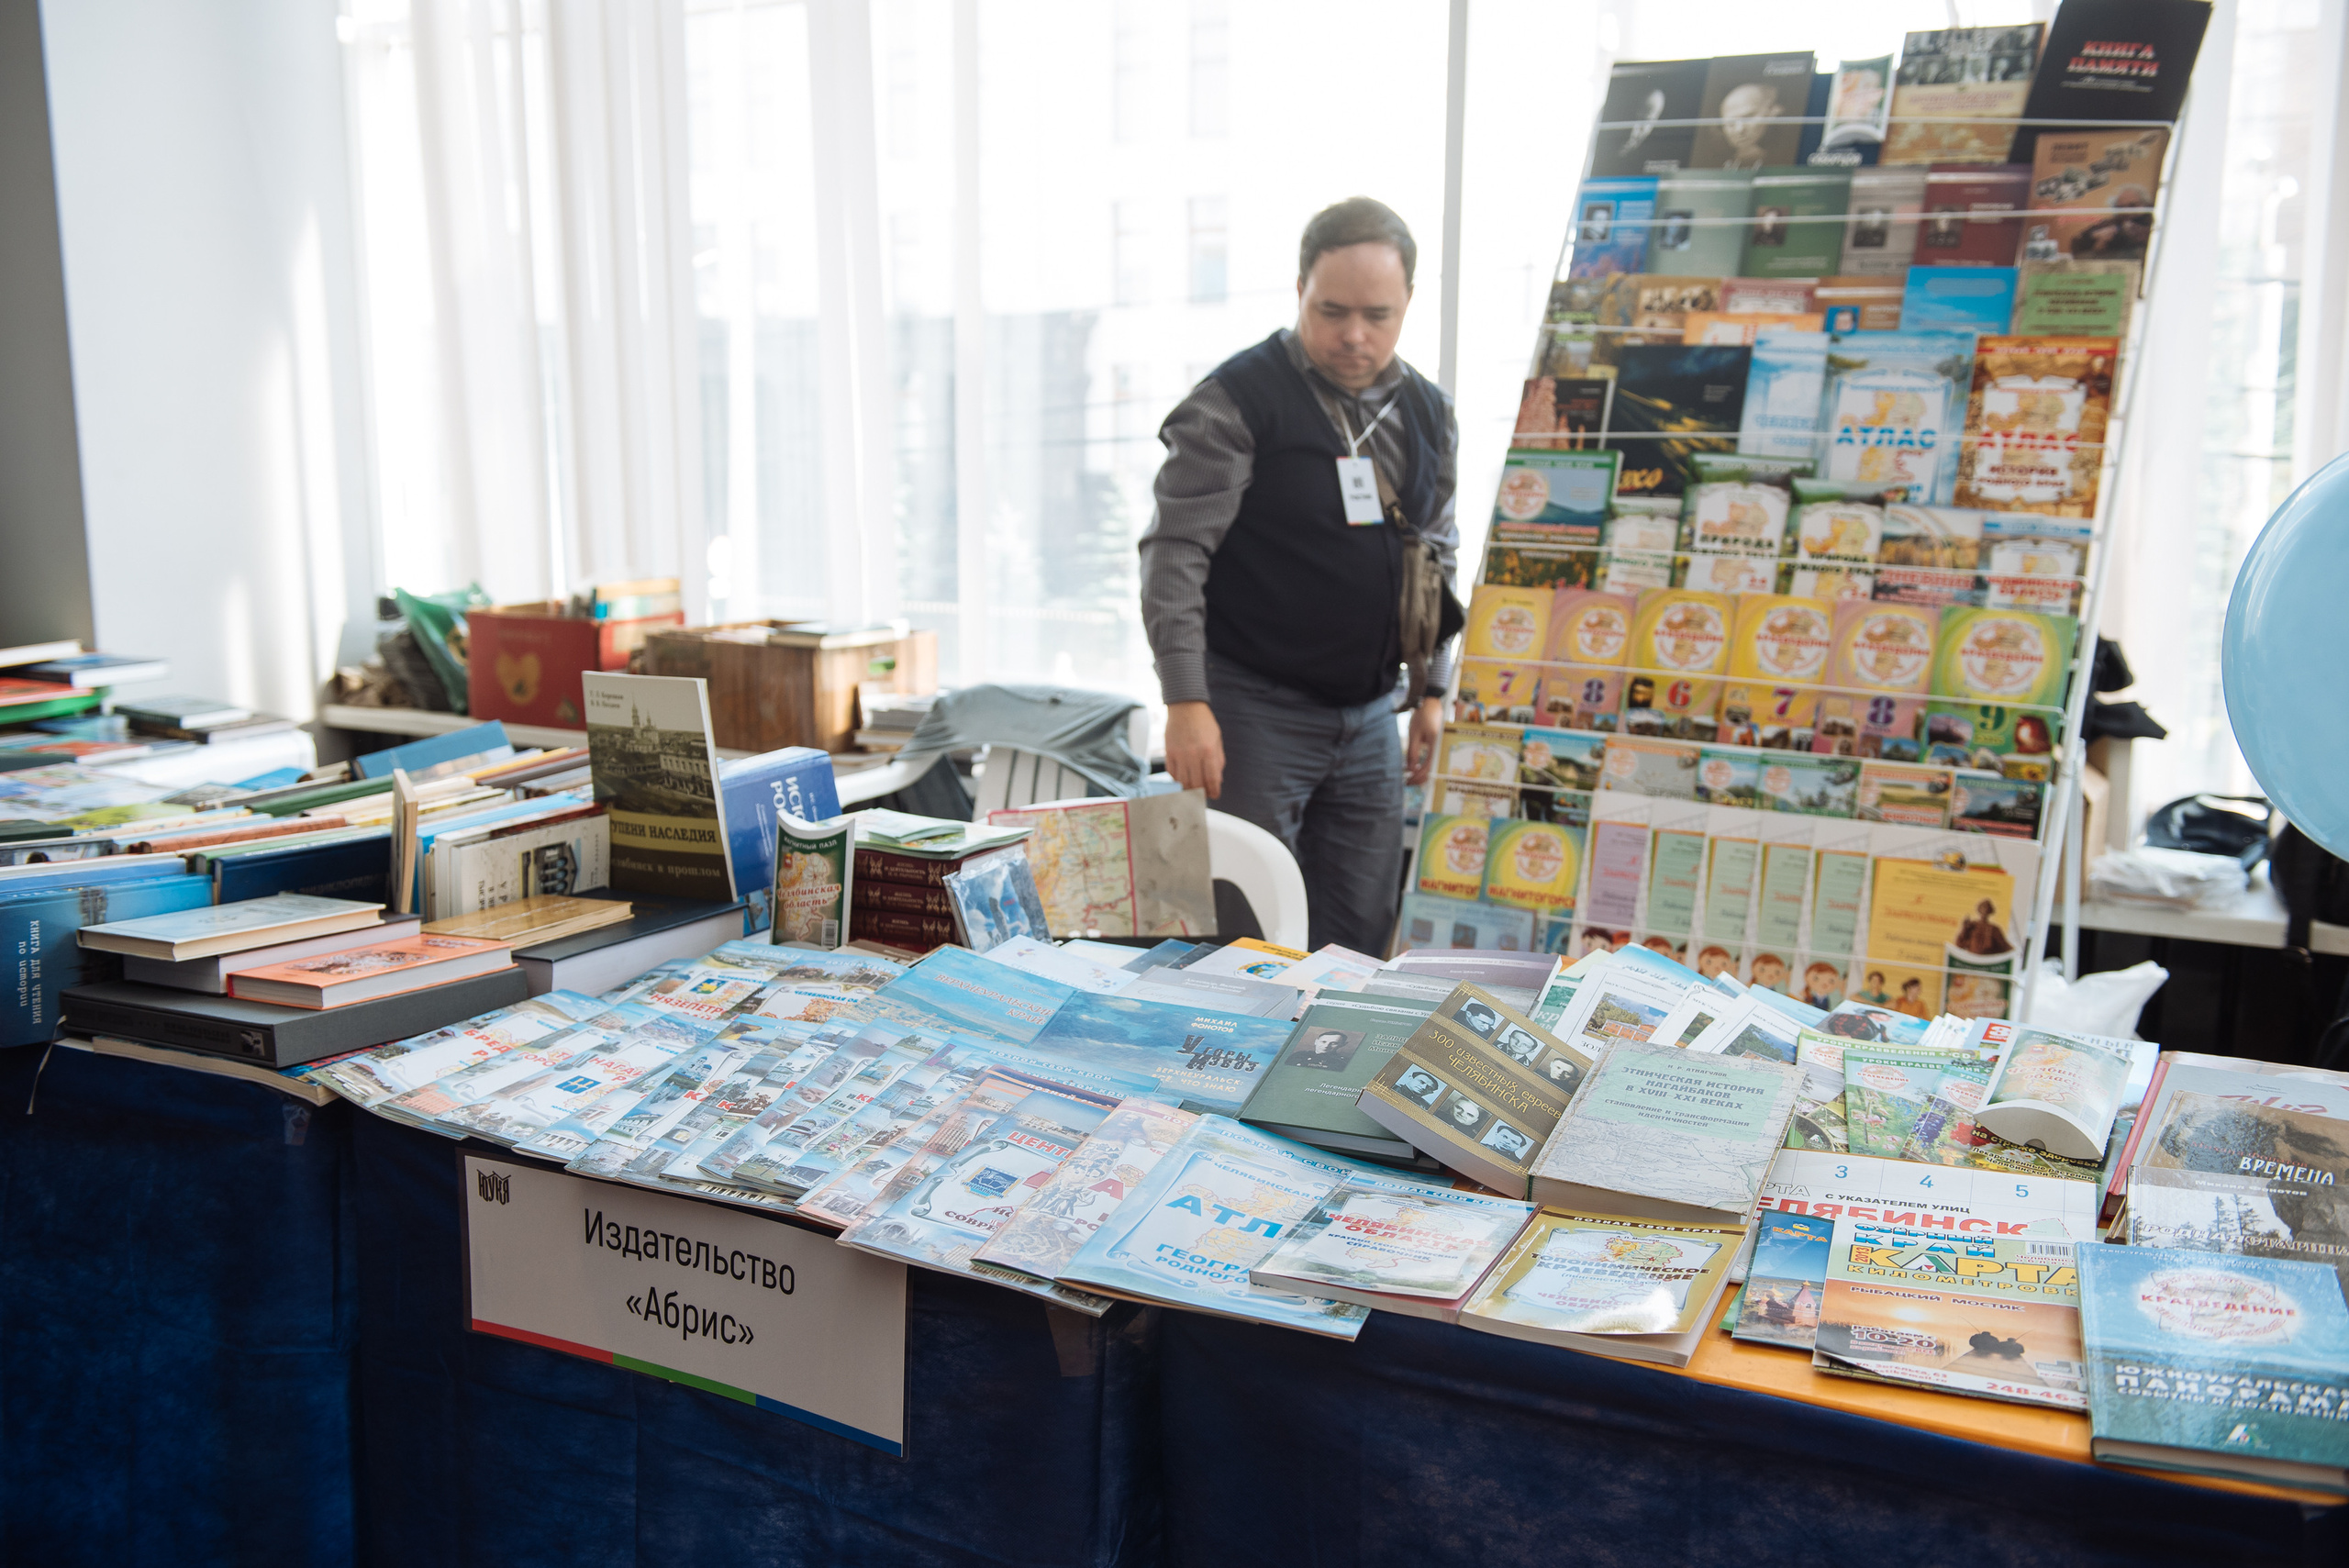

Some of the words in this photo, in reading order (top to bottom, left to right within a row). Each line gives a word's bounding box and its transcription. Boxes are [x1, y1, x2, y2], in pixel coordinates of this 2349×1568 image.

[2079, 39, 2155, 60] КНИГА
[2065, 56, 2161, 78] ПАМЯТИ
[1836, 426, 1939, 450] АТЛАС
[1976, 430, 2082, 452] АТЛАС
[1498, 671, 1516, 695] 7
[1583, 677, 1605, 705] 8
[1667, 680, 1692, 708] 6
[1772, 688, 1798, 717] 7
[1866, 695, 1896, 727] 8
[1978, 704, 2007, 732] 9
[648, 825, 718, 843] НАСЛЕДИЯ
[784, 835, 818, 851] МАГНИТНЫЙ
[818, 840, 838, 850] ПАЗЛ
[783, 899, 829, 910] область
[18, 940, 27, 955] по
[29, 919, 40, 954] КНИГА
[30, 959, 41, 979] ДЛЯ
[17, 960, 28, 1007] истории
[31, 984, 42, 1025] ЧТЕНИЯ
[934, 973, 1056, 1017] ВЕРХНЕУРАЛЬСКИЙ
[1190, 1021, 1234, 1033] ФОНОТОВ
[1195, 1016, 1238, 1028] МИХАИЛ
[1816, 1036, 1853, 1049] УРОКИ
[1854, 1044, 1937, 1058] КРАЕВЕДЕНИЯ
[1952, 1051, 1972, 1060] CD
[1862, 1056, 1898, 1067] УРОКИ
[1156, 1066, 1245, 1086] ВЕРХНЕУРАЛЬСК:
[1180, 1078, 1201, 1087] ЧТО
[1203, 1082, 1237, 1093] ЗНАЮ
[1428, 1029, 1455, 1050] 300
[1455, 1046, 1520, 1094] известных
[1521, 1089, 1563, 1120] евреев
[1448, 1053, 1530, 1114] ЧЕЛЯБИНСКА
[1620, 1065, 1703, 1086] ЭТНИЧЕСКАЯ
[1706, 1081, 1765, 1095] ИСТОРИЯ
[1856, 1071, 1910, 1083] КРАЕВЕДЕНИЕ
[1304, 1086, 1361, 1100] легендарного
[1645, 1079, 1731, 1100] НАГАЙБАКОВ
[1604, 1098, 1663, 1114] становление
[1675, 1110, 1751, 1128] трансформация
[1699, 1097, 1745, 1110] ВЕКАХ
[1637, 1111, 1709, 1128] идентичностей
[1971, 1129, 1987, 1140] на
[1219, 1129, 1296, 1160] ПОЗНАЙ
[1301, 1156, 1353, 1176] СВОЙ
[1834, 1164, 1849, 1179] 3
[1972, 1147, 2046, 1171] Лекарственные
[2047, 1165, 2095, 1182] растения
[2239, 1155, 2335, 1185] ВРЕМЕНА
[1213, 1162, 1307, 1198] ЧЕЛЯБИНСКАЯ
[1374, 1181, 1430, 1195] ПОЗНАЙ
[1920, 1174, 1934, 1189] 4
[2014, 1184, 2030, 1198] 5
[2194, 1179, 2246, 1191] Михаил
[2248, 1185, 2309, 1196] Фонотов
[1838, 1194, 1928, 1210] УКАЗАТЕЛЕМ
[1932, 1204, 1971, 1214] УЛИЦ
[1164, 1195, 1286, 1240] АТЛ
[1573, 1216, 1632, 1228] ПОЗНАЙ
[1638, 1223, 1676, 1232] СВОЙ
[1327, 1213, 1494, 1247] ЧЕЛЯБИНСКАЯ
[1344, 1225, 1472, 1251] ОБЛАСТЬ
[1772, 1225, 1829, 1243] КАРТА
[2142, 1222, 2246, 1244] РОДНАЯ
[584, 1207, 796, 1296] Издательство
[1327, 1233, 1372, 1244] КРАТКИЙ
[1373, 1241, 1459, 1260] ГЕОГРАФИЧЕСКИЙ
[1345, 1240, 1432, 1262] СПРАВОЧНИК
[1853, 1231, 1997, 1259] КРАЙ
[1854, 1245, 1870, 1264] 2013
[1154, 1255, 1249, 1284] РОДНОГО
[1531, 1252, 1712, 1274] ТОПОНИМИЧЕСКОЕ
[1536, 1261, 1696, 1281] КРАЕВЕДЕНИЕ
[1849, 1244, 2078, 1286] КАРТА
[1850, 1286, 1943, 1303] РЫБАЦКИЙ
[1951, 1297, 2027, 1313] МОСТИК
[2141, 1293, 2297, 1318] КРАЕВЕДЕНИЕ
[626, 1286, 755, 1346] «Абрис»
[1849, 1330, 1938, 1349] 10-20
[1851, 1325, 1925, 1340] Работаем
